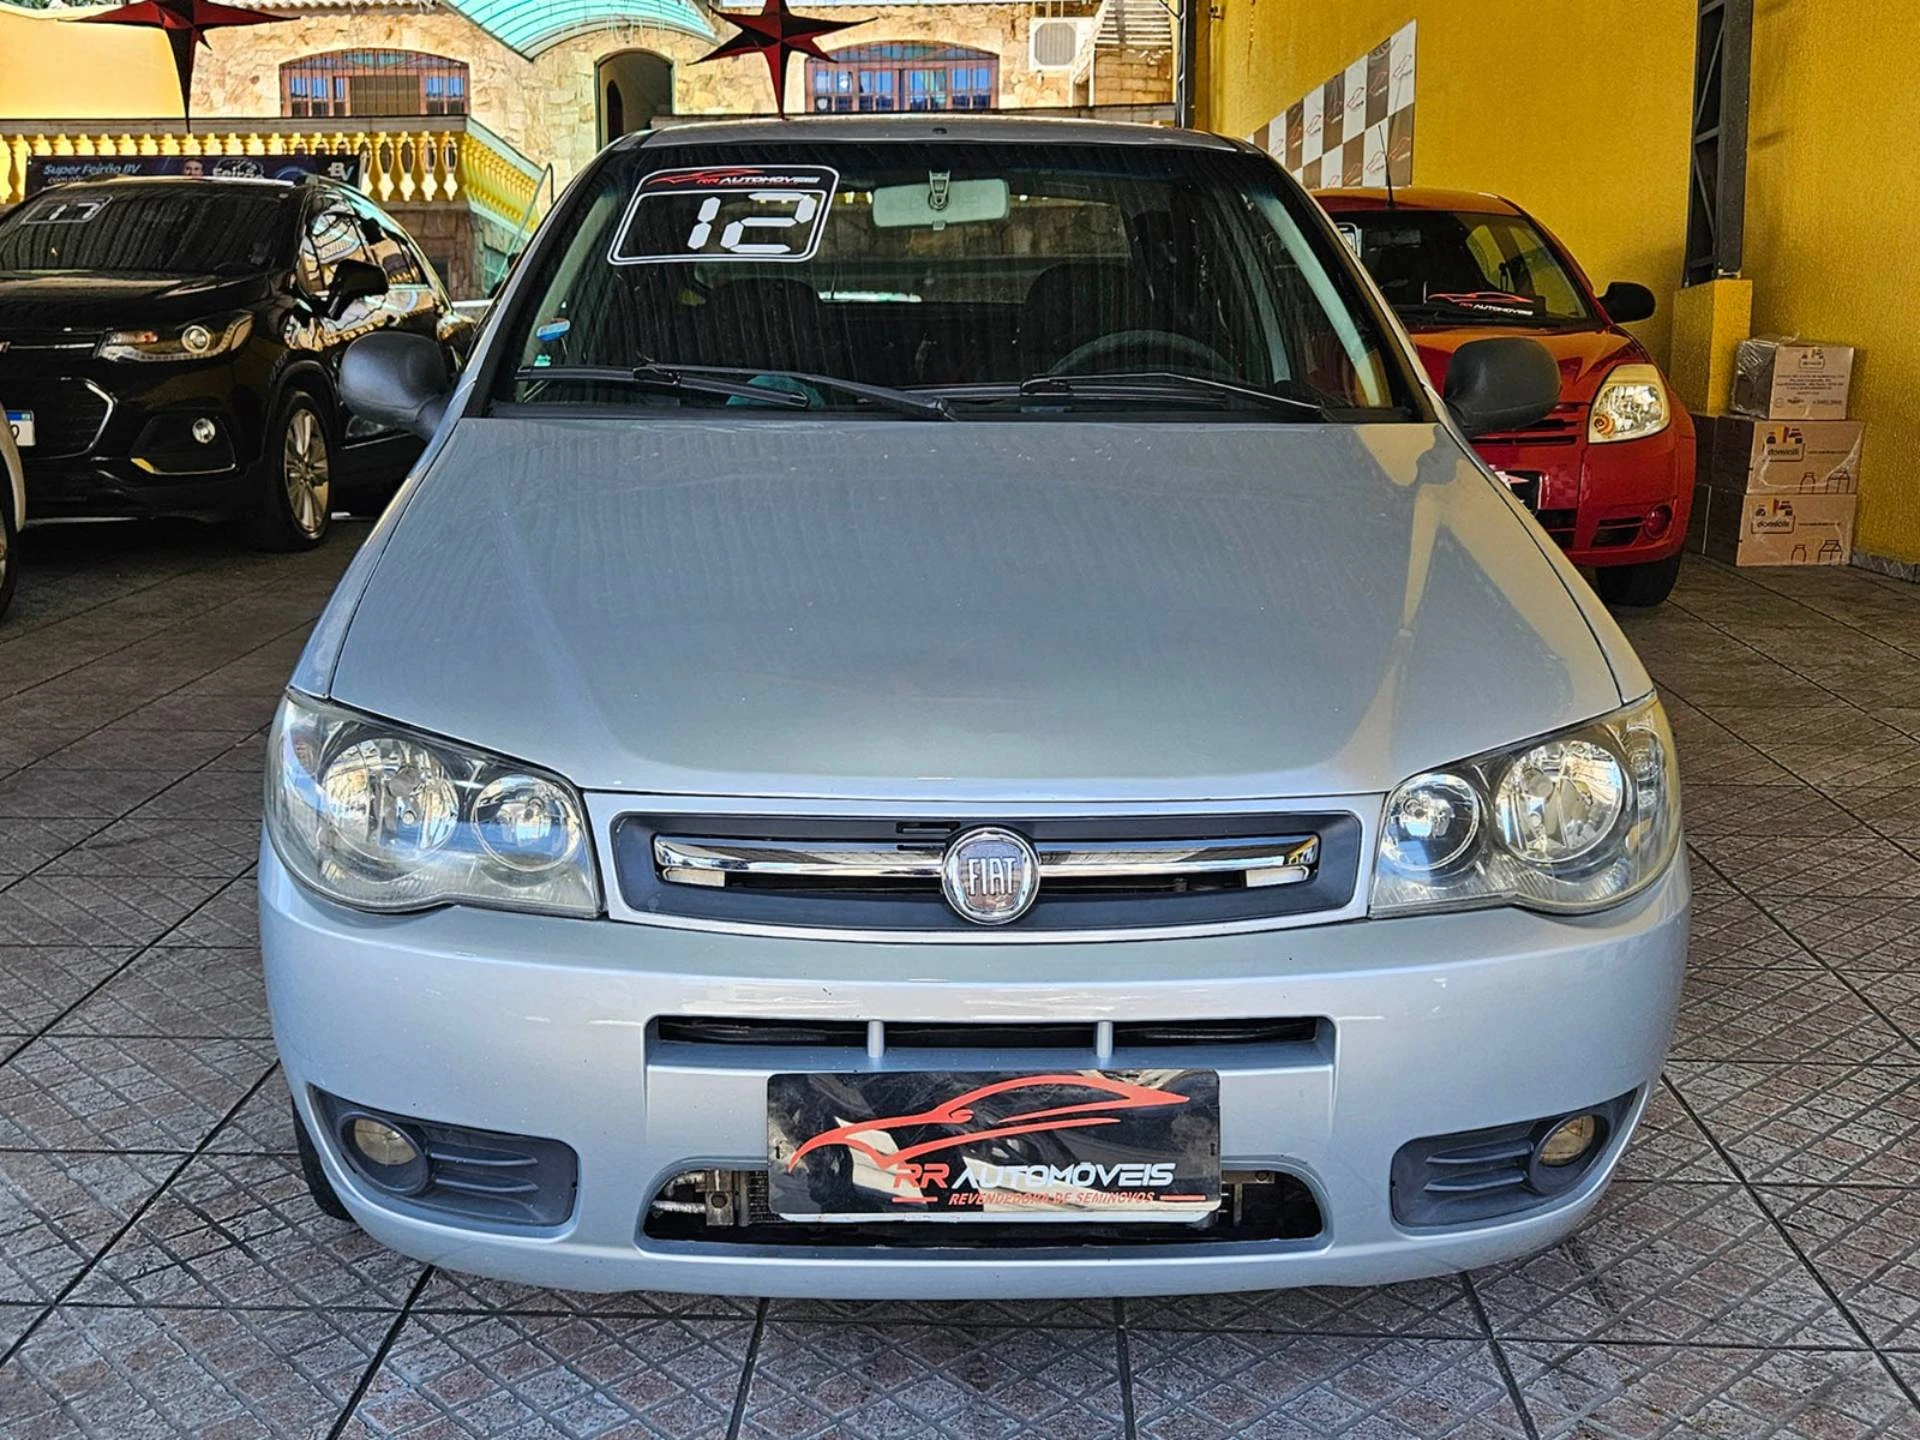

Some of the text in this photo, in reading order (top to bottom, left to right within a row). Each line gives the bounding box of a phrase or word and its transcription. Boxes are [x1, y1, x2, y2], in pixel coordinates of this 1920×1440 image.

[43, 164, 80, 175] Super
[122, 164, 141, 174] BV
[48, 202, 100, 220] 17
[687, 191, 817, 254] 12
[967, 857, 1017, 895] FIAT
[893, 1163, 950, 1188] RR
[948, 1191, 1155, 1206] REVENDEDORA DE SEMINOVOS
